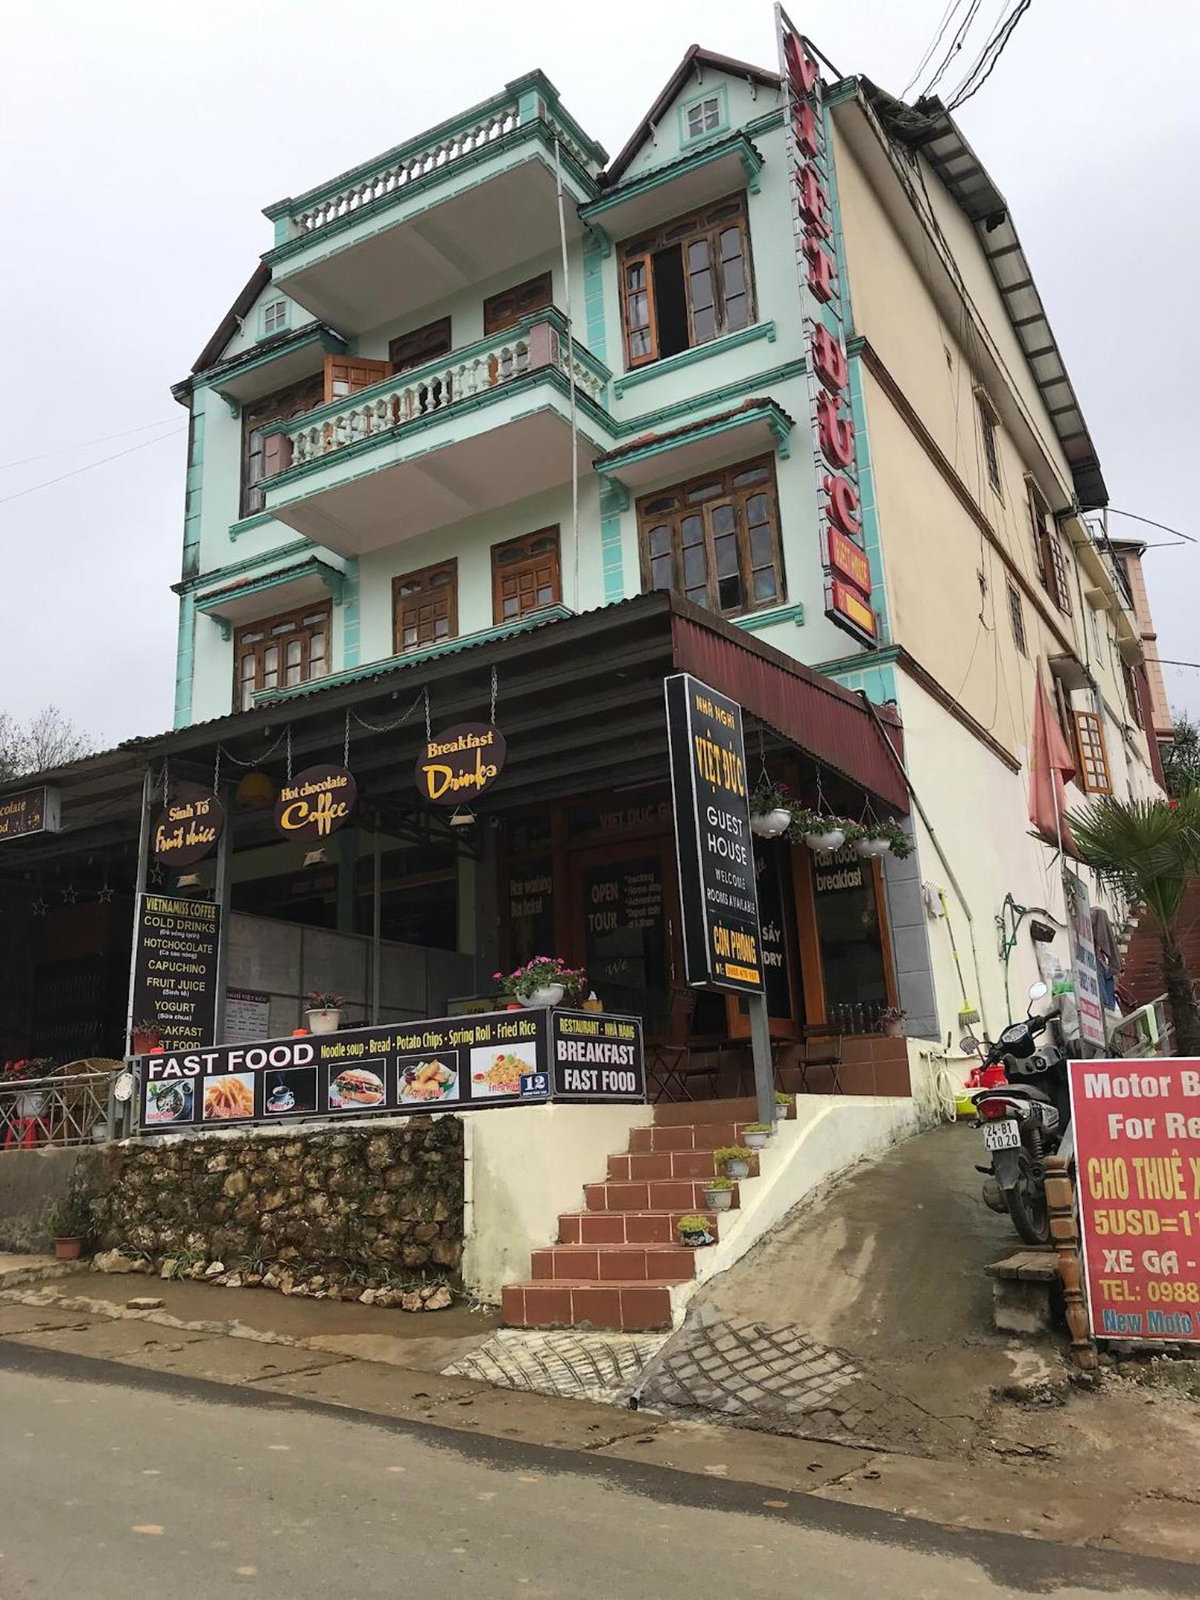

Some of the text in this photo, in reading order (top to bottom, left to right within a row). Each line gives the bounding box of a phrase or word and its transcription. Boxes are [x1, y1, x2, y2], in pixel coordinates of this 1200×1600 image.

[427, 731, 494, 759] Breakfast
[695, 729, 744, 797] VIỆT ĐỨC
[281, 775, 347, 802] Hot chocolate
[168, 797, 210, 822] Sinh Tố
[280, 792, 349, 836] Coffee
[706, 806, 743, 837] GUEST
[708, 833, 748, 866] HOUSE
[714, 867, 746, 890] WELCOME
[816, 867, 862, 892] breakfast
[590, 881, 619, 904] OPEN
[706, 887, 755, 915] ROOMS AVAILABLE
[190, 903, 216, 919] COFFEE
[588, 911, 618, 932] TOUR
[144, 915, 216, 934] COLD DRINKS
[762, 920, 781, 943] SẤY
[144, 937, 213, 954] HOTCHOCOLATE
[148, 959, 206, 975] CAPUCHINO
[761, 951, 783, 967] DRY
[146, 976, 206, 992] FRUIT JUICE
[154, 1000, 196, 1013] YOGURT
[559, 1017, 600, 1036] RESTAURANT
[173, 1041, 200, 1051] FOOD
[320, 1020, 536, 1059] Noodle soup Bread Potato Chips Spring Roll Fried Rice
[148, 1044, 314, 1079] FAST FOOD
[557, 1040, 635, 1066] BREAKFAST
[524, 1075, 546, 1091] 12
[564, 1069, 636, 1092] FAST FOOD
[1083, 1071, 1200, 1099] Motor B
[1107, 1112, 1200, 1140] For Re
[1087, 1157, 1129, 1200] CHO
[1132, 1148, 1187, 1200] THUÊ
[1102, 1249, 1179, 1276] XE GA
[1098, 1280, 1141, 1301] TEL:
[1102, 1309, 1142, 1333] New
[1146, 1309, 1193, 1334] Moto
